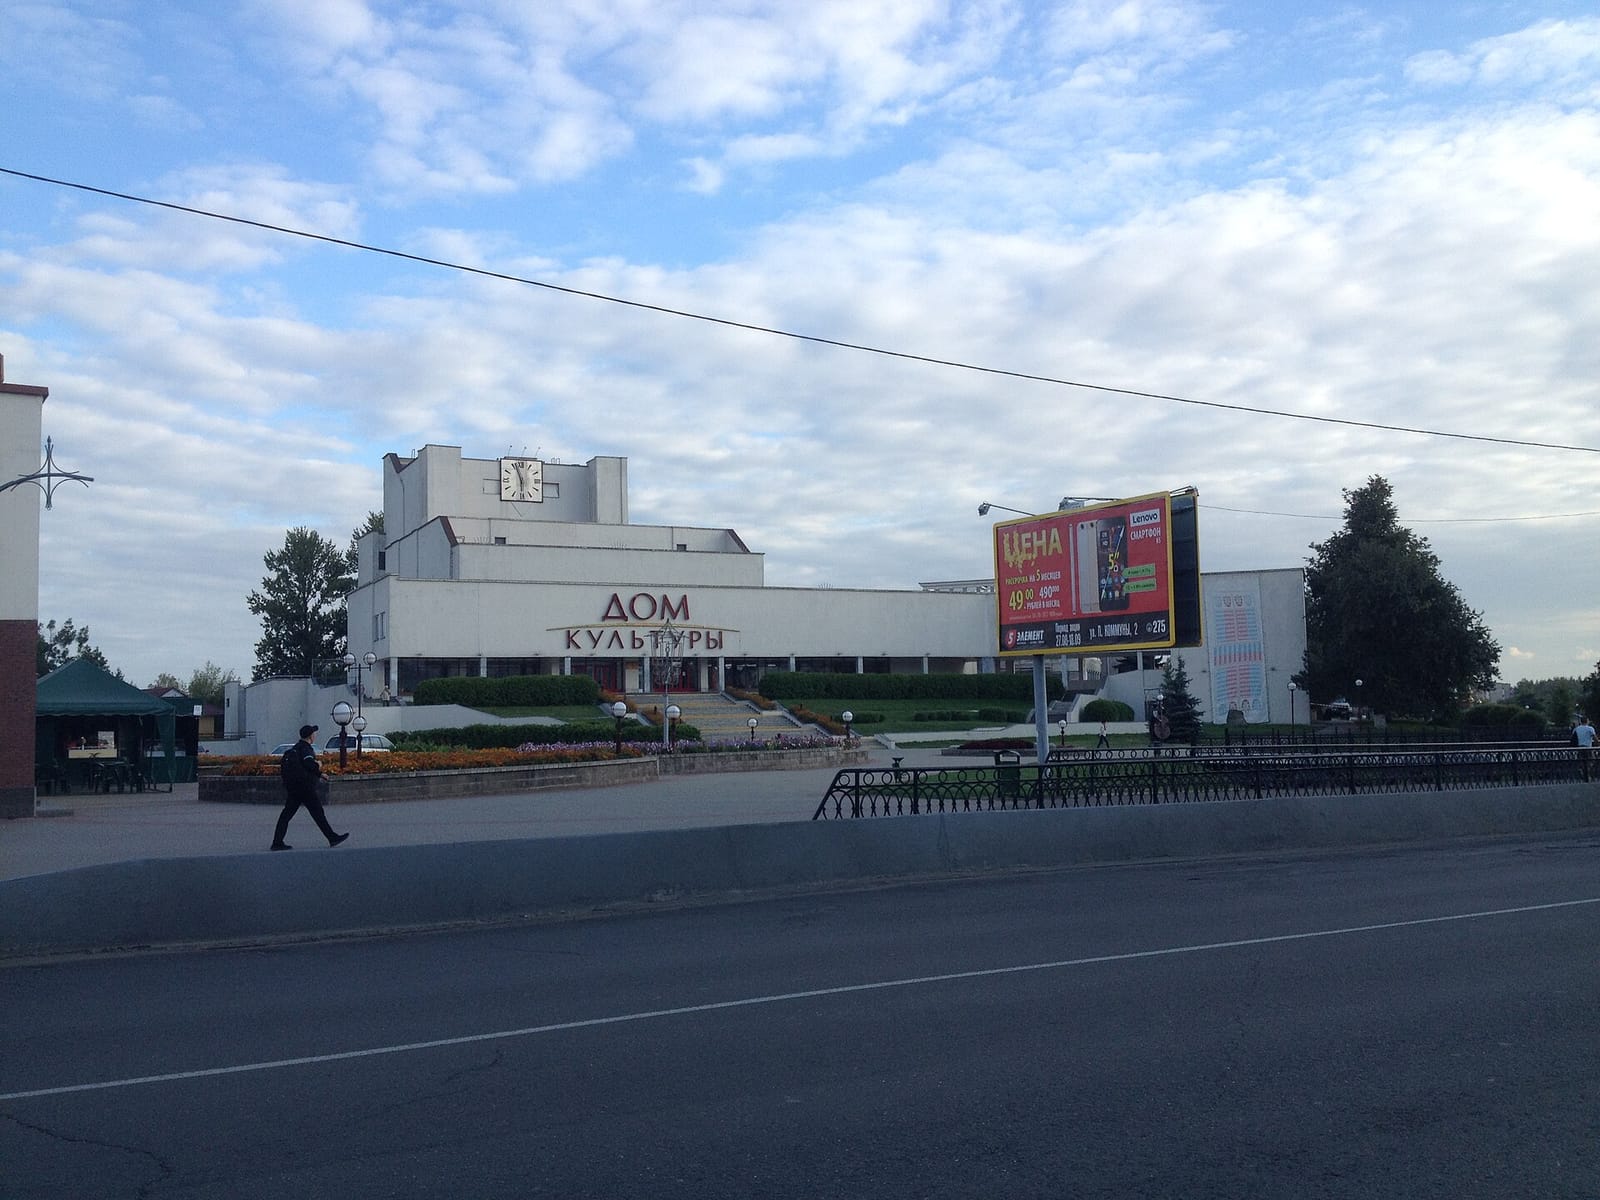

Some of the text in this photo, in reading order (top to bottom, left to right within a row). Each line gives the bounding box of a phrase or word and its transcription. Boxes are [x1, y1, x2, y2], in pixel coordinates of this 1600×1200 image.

[1132, 511, 1158, 524] Lenovo
[1130, 527, 1161, 541] СМАРТФОН
[1003, 527, 1063, 569] ЦЕНА
[1036, 569, 1041, 582] 5
[602, 592, 690, 621] ДОМ
[1133, 622, 1138, 635] 2
[1152, 619, 1166, 633] 275
[566, 629, 723, 650] КУЛЬТУРЫ
[1008, 632, 1014, 645] 5
[1016, 630, 1045, 642] ЭЛЕМЕНТ
